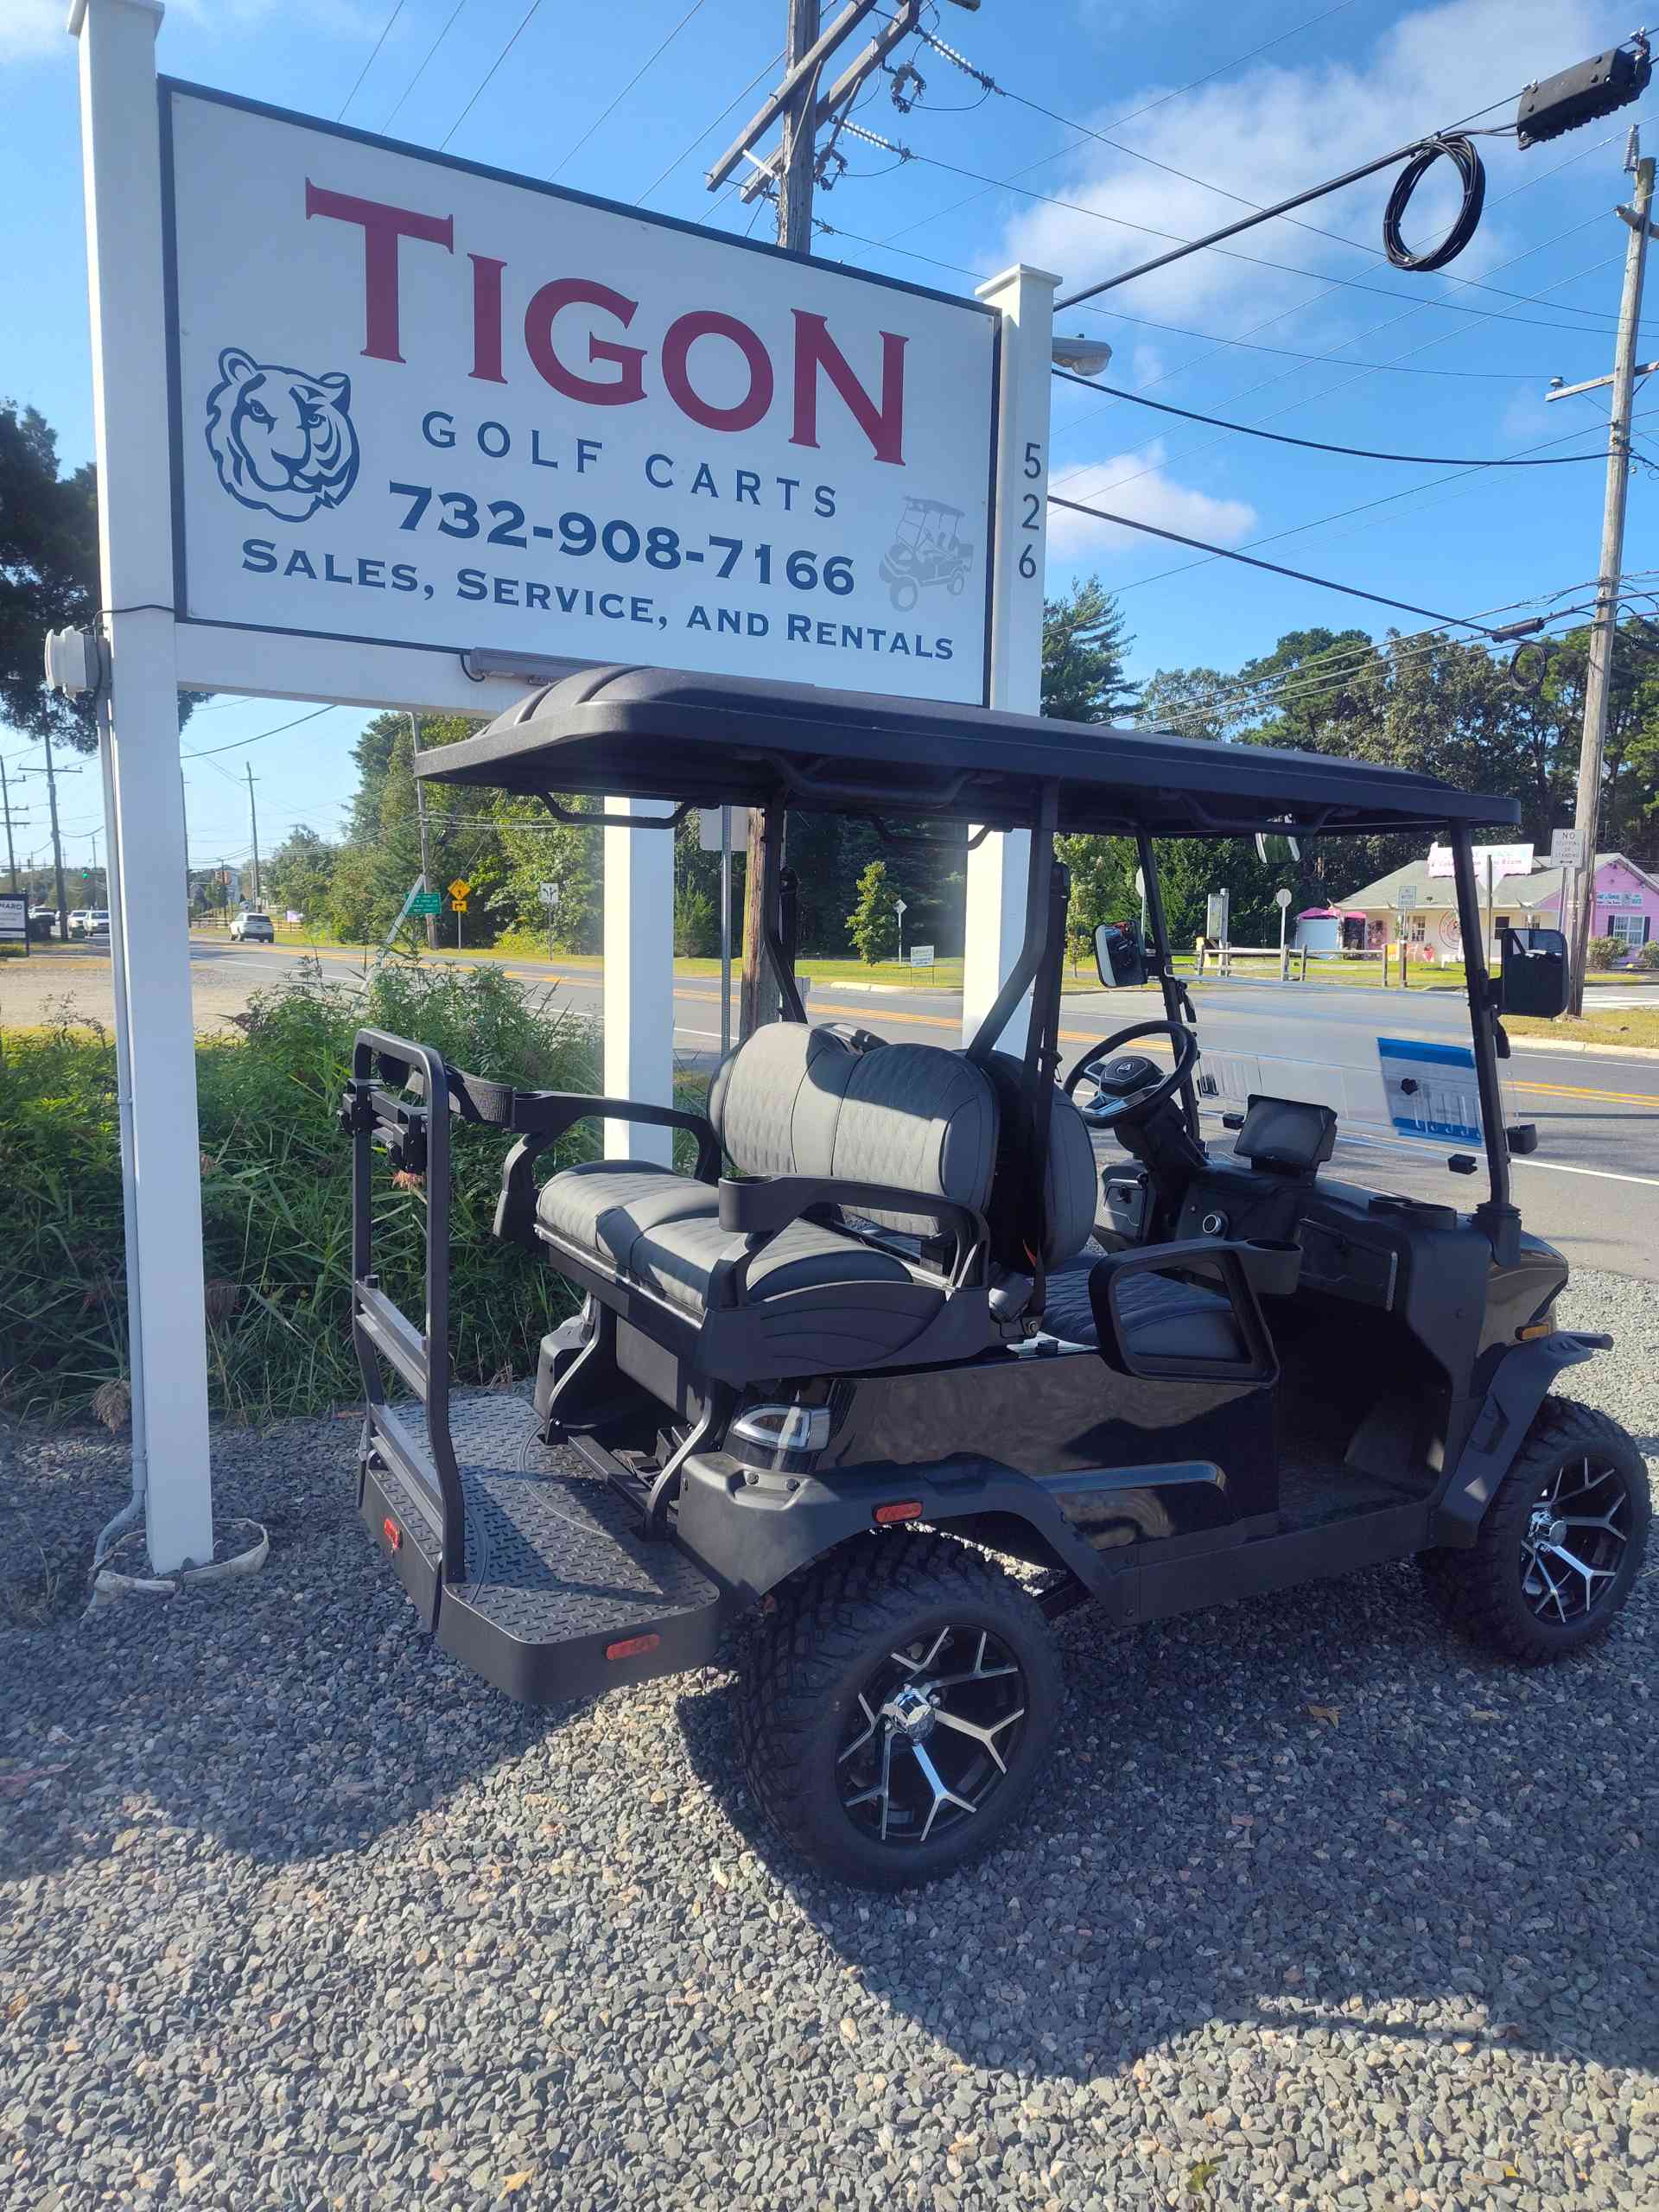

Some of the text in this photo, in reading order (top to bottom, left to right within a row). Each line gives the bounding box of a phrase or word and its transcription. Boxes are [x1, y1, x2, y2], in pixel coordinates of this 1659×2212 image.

[304, 176, 910, 467] TIGON
[422, 410, 836, 518] GOLF CARTS
[389, 480, 855, 596] 732-908-7166
[241, 538, 954, 660] SALES, SERVICE, AND RENTALS
